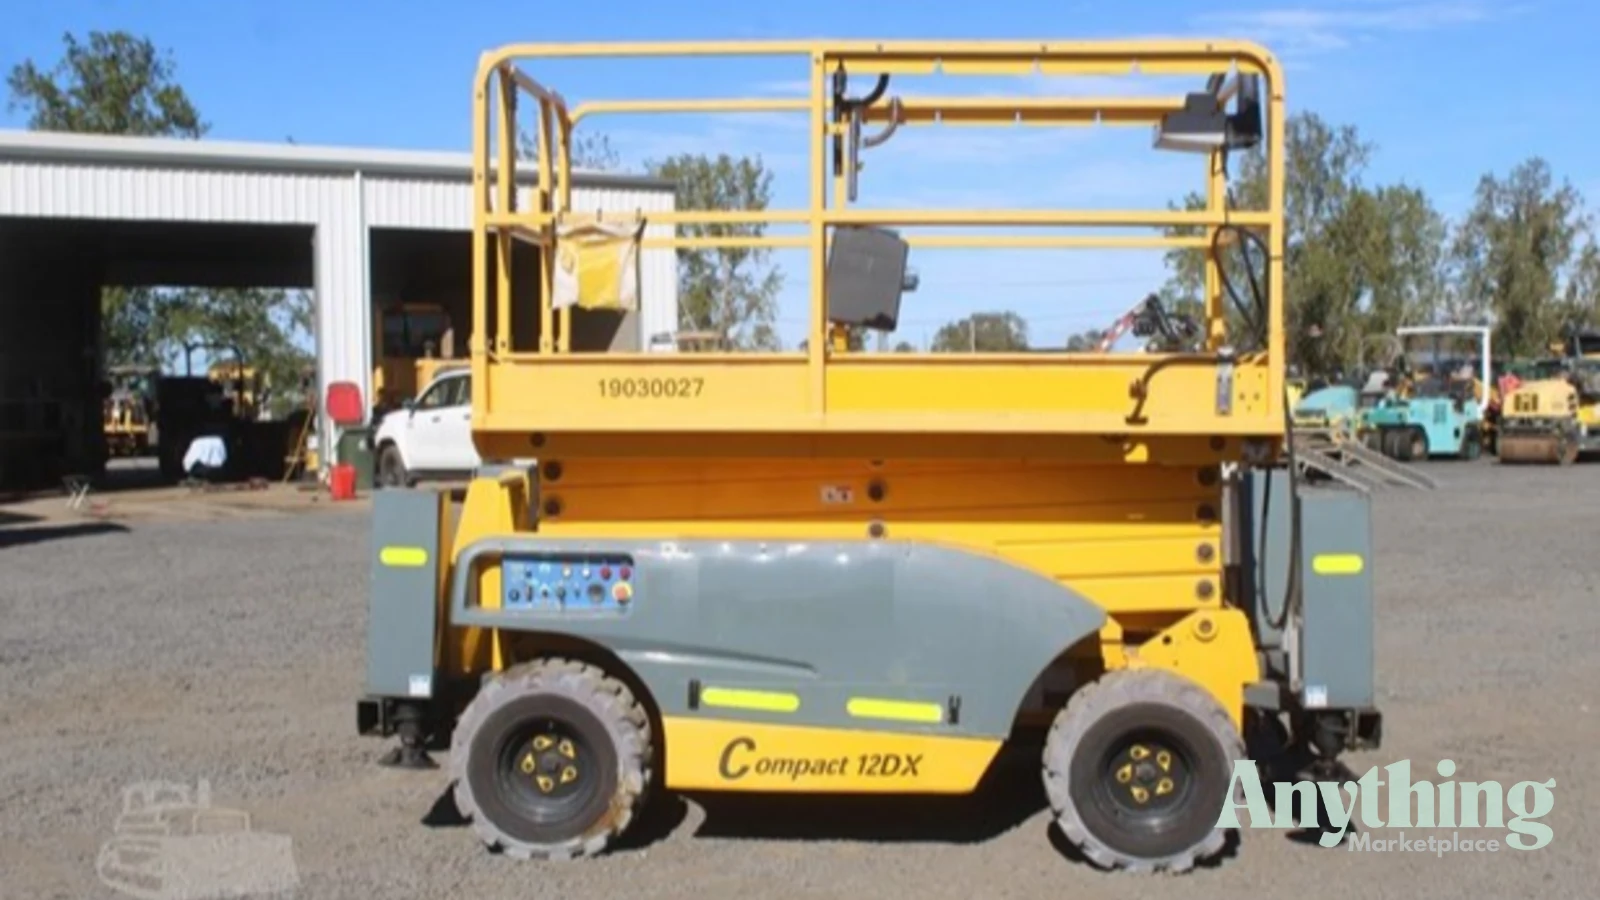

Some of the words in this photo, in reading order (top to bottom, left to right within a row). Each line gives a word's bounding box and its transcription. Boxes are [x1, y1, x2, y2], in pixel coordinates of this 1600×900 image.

[598, 378, 704, 397] 19030027
[719, 737, 849, 780] Compact
[857, 753, 922, 777] 12DX
